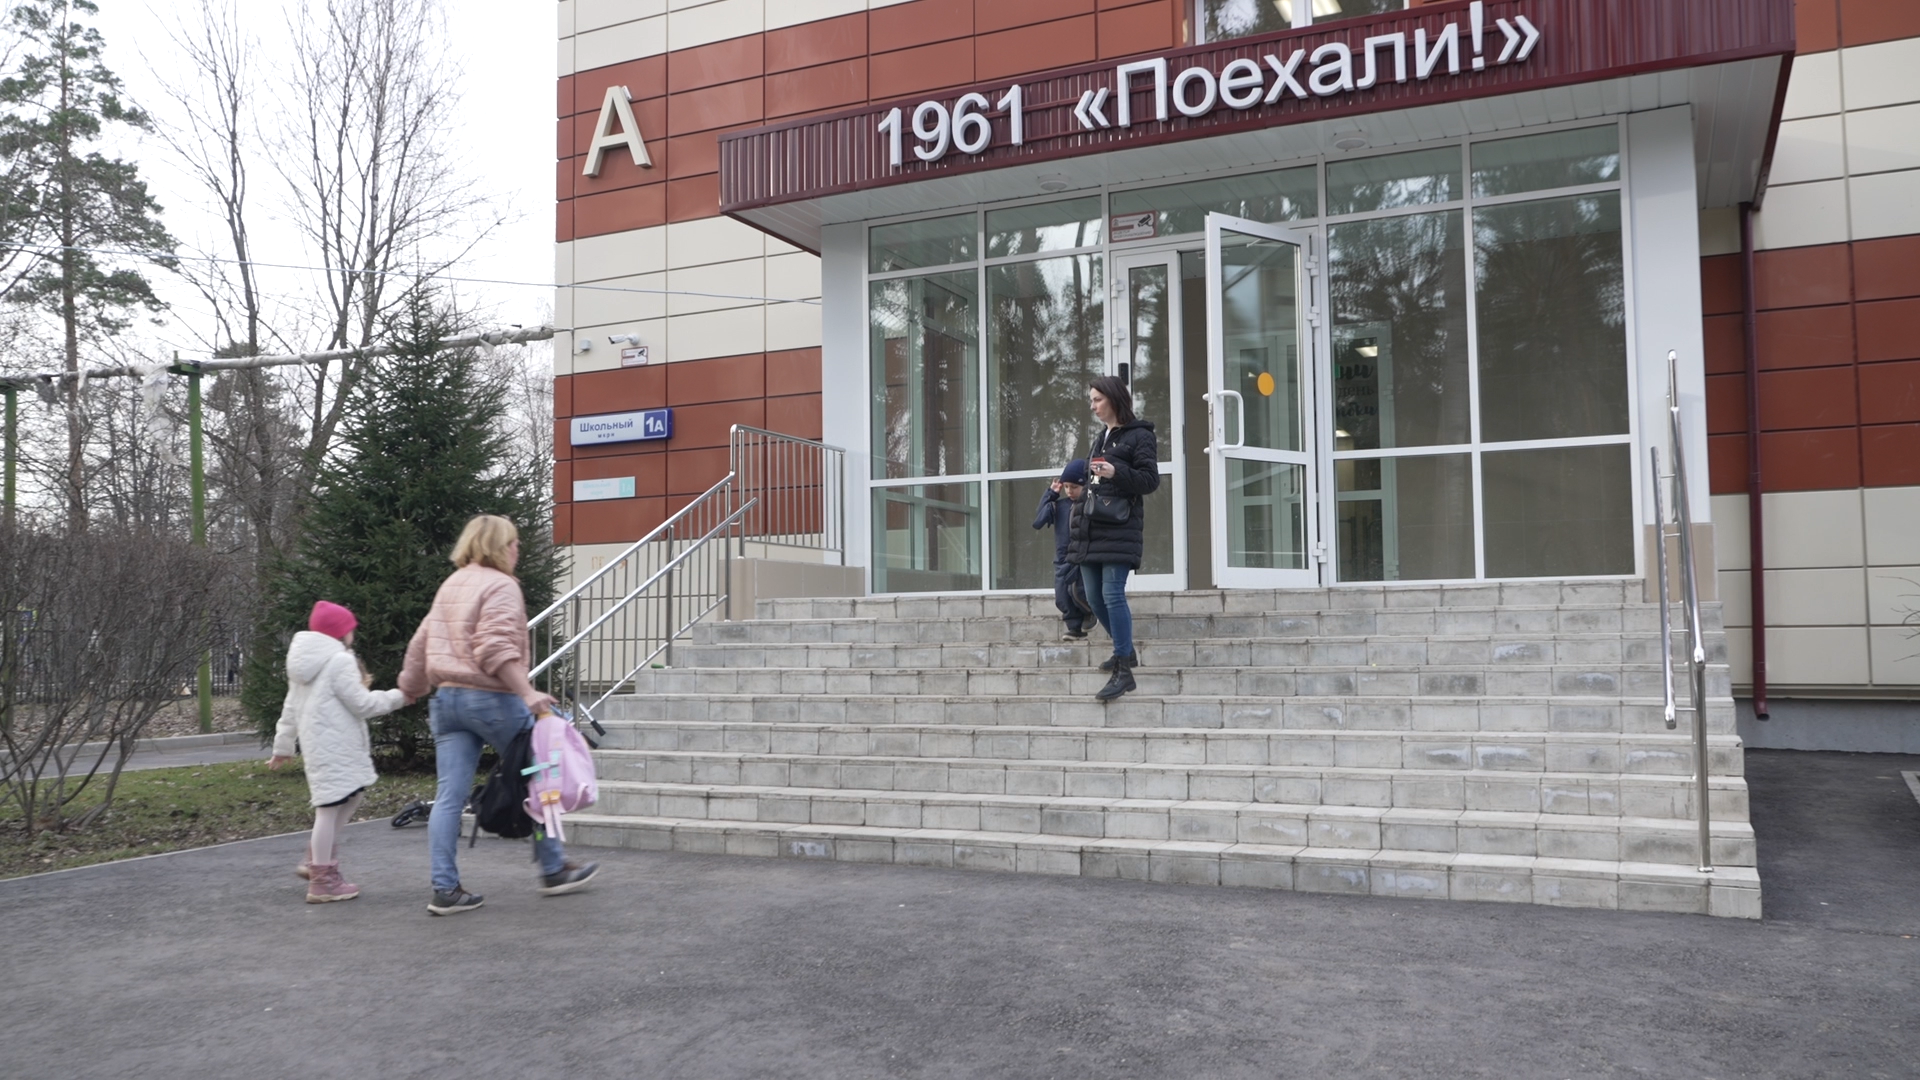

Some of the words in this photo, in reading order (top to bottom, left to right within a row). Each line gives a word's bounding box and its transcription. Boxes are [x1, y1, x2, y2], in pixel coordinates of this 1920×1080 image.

[878, 84, 1023, 167] 1961
[1074, 1, 1540, 130] «Поехали!»
[582, 85, 652, 177] А
[580, 418, 633, 432] Школьный
[645, 416, 664, 433] 1А
